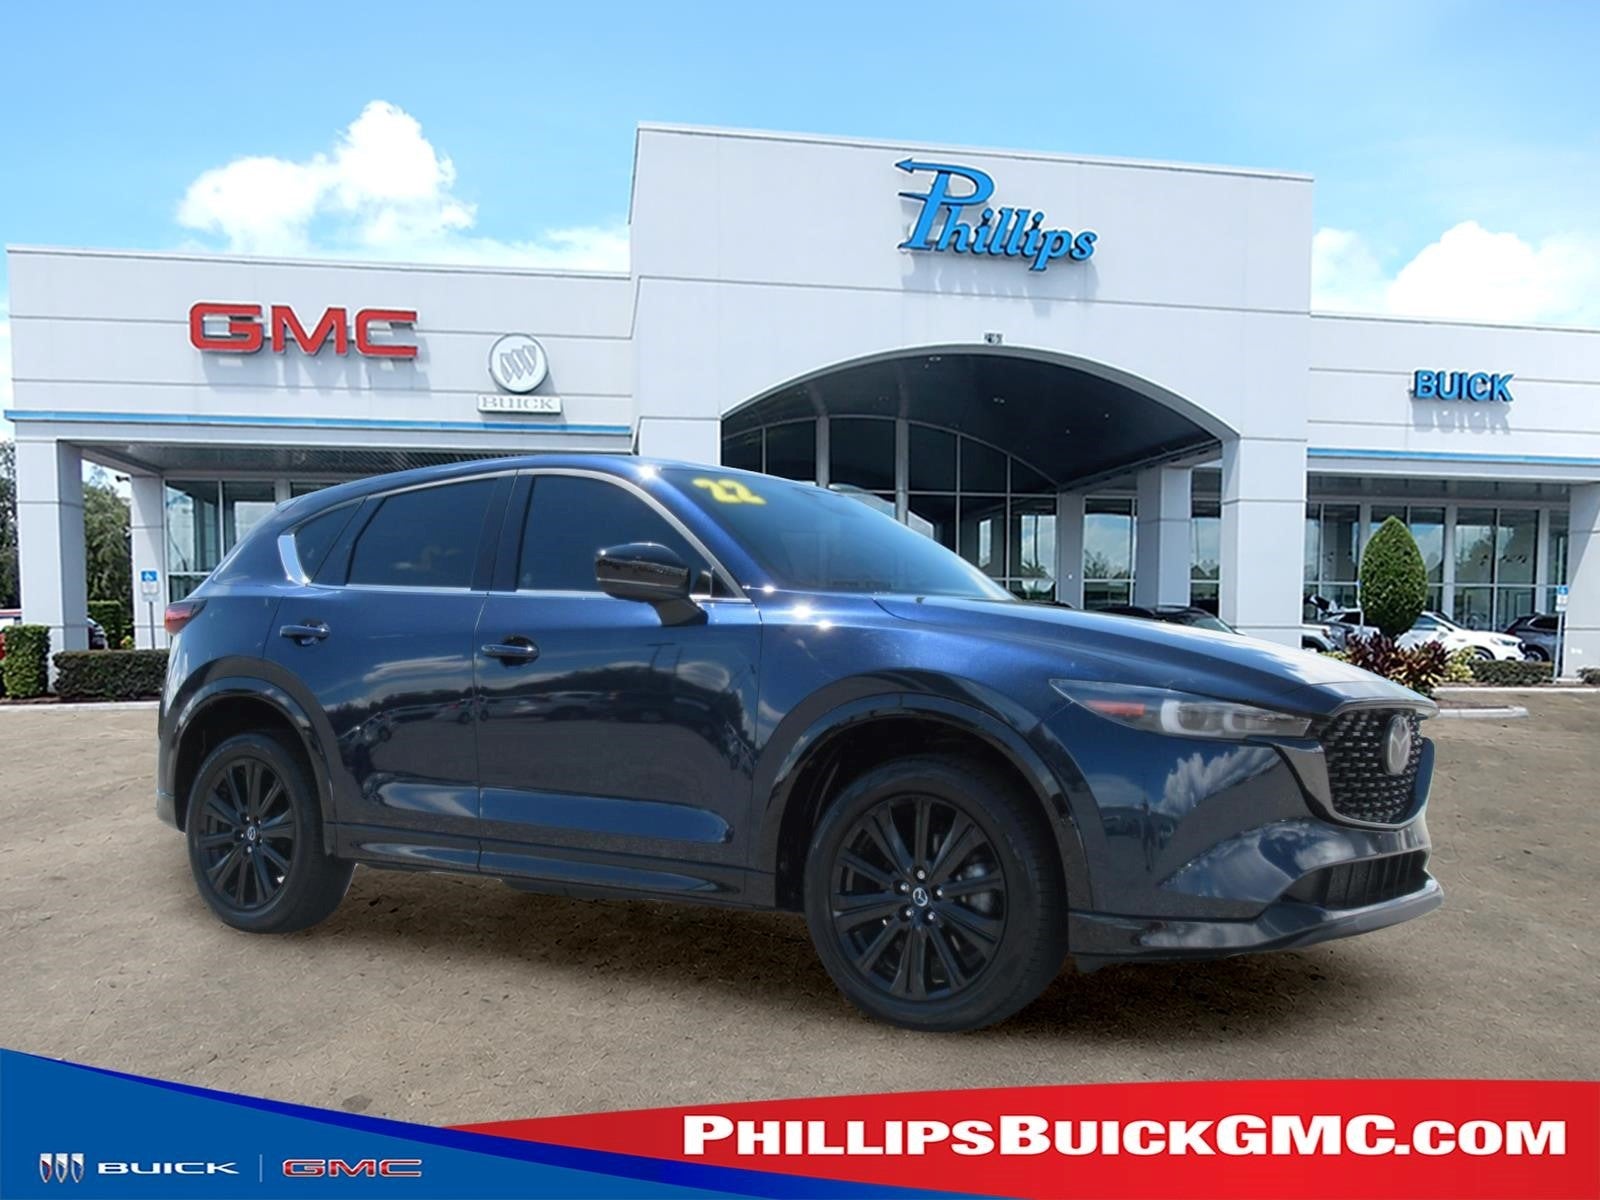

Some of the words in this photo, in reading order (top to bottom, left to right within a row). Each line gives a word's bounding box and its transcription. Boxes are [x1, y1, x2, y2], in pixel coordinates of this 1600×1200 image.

[896, 158, 1098, 271] Phillips
[189, 301, 418, 360] GMC
[1414, 370, 1514, 402] BUICK
[482, 396, 554, 410] BUICK
[692, 477, 766, 505] 22
